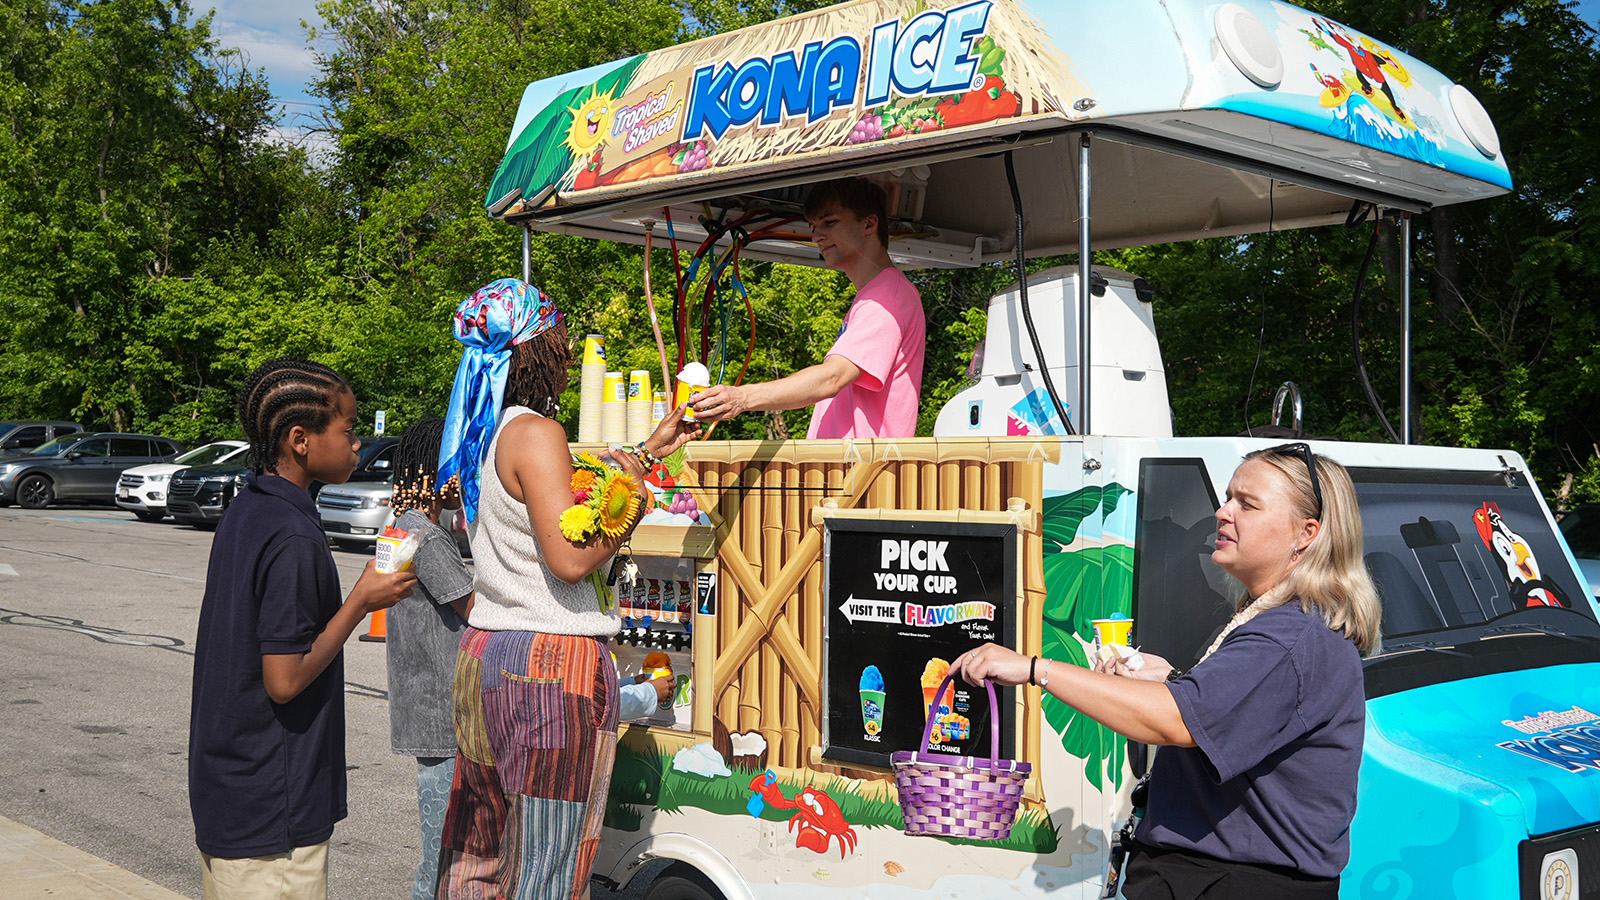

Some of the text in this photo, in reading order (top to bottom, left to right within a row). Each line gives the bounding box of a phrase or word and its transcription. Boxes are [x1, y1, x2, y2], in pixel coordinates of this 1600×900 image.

[683, 1, 993, 140] KONA ICE
[613, 83, 674, 136] Tropical
[625, 102, 682, 152] Shaved
[881, 539, 950, 572] PICK
[874, 572, 958, 594] YOUR CUP.
[849, 601, 995, 627] VISIT THE FLAVORWAVE
[928, 743, 961, 754] OLOR CHANGE
